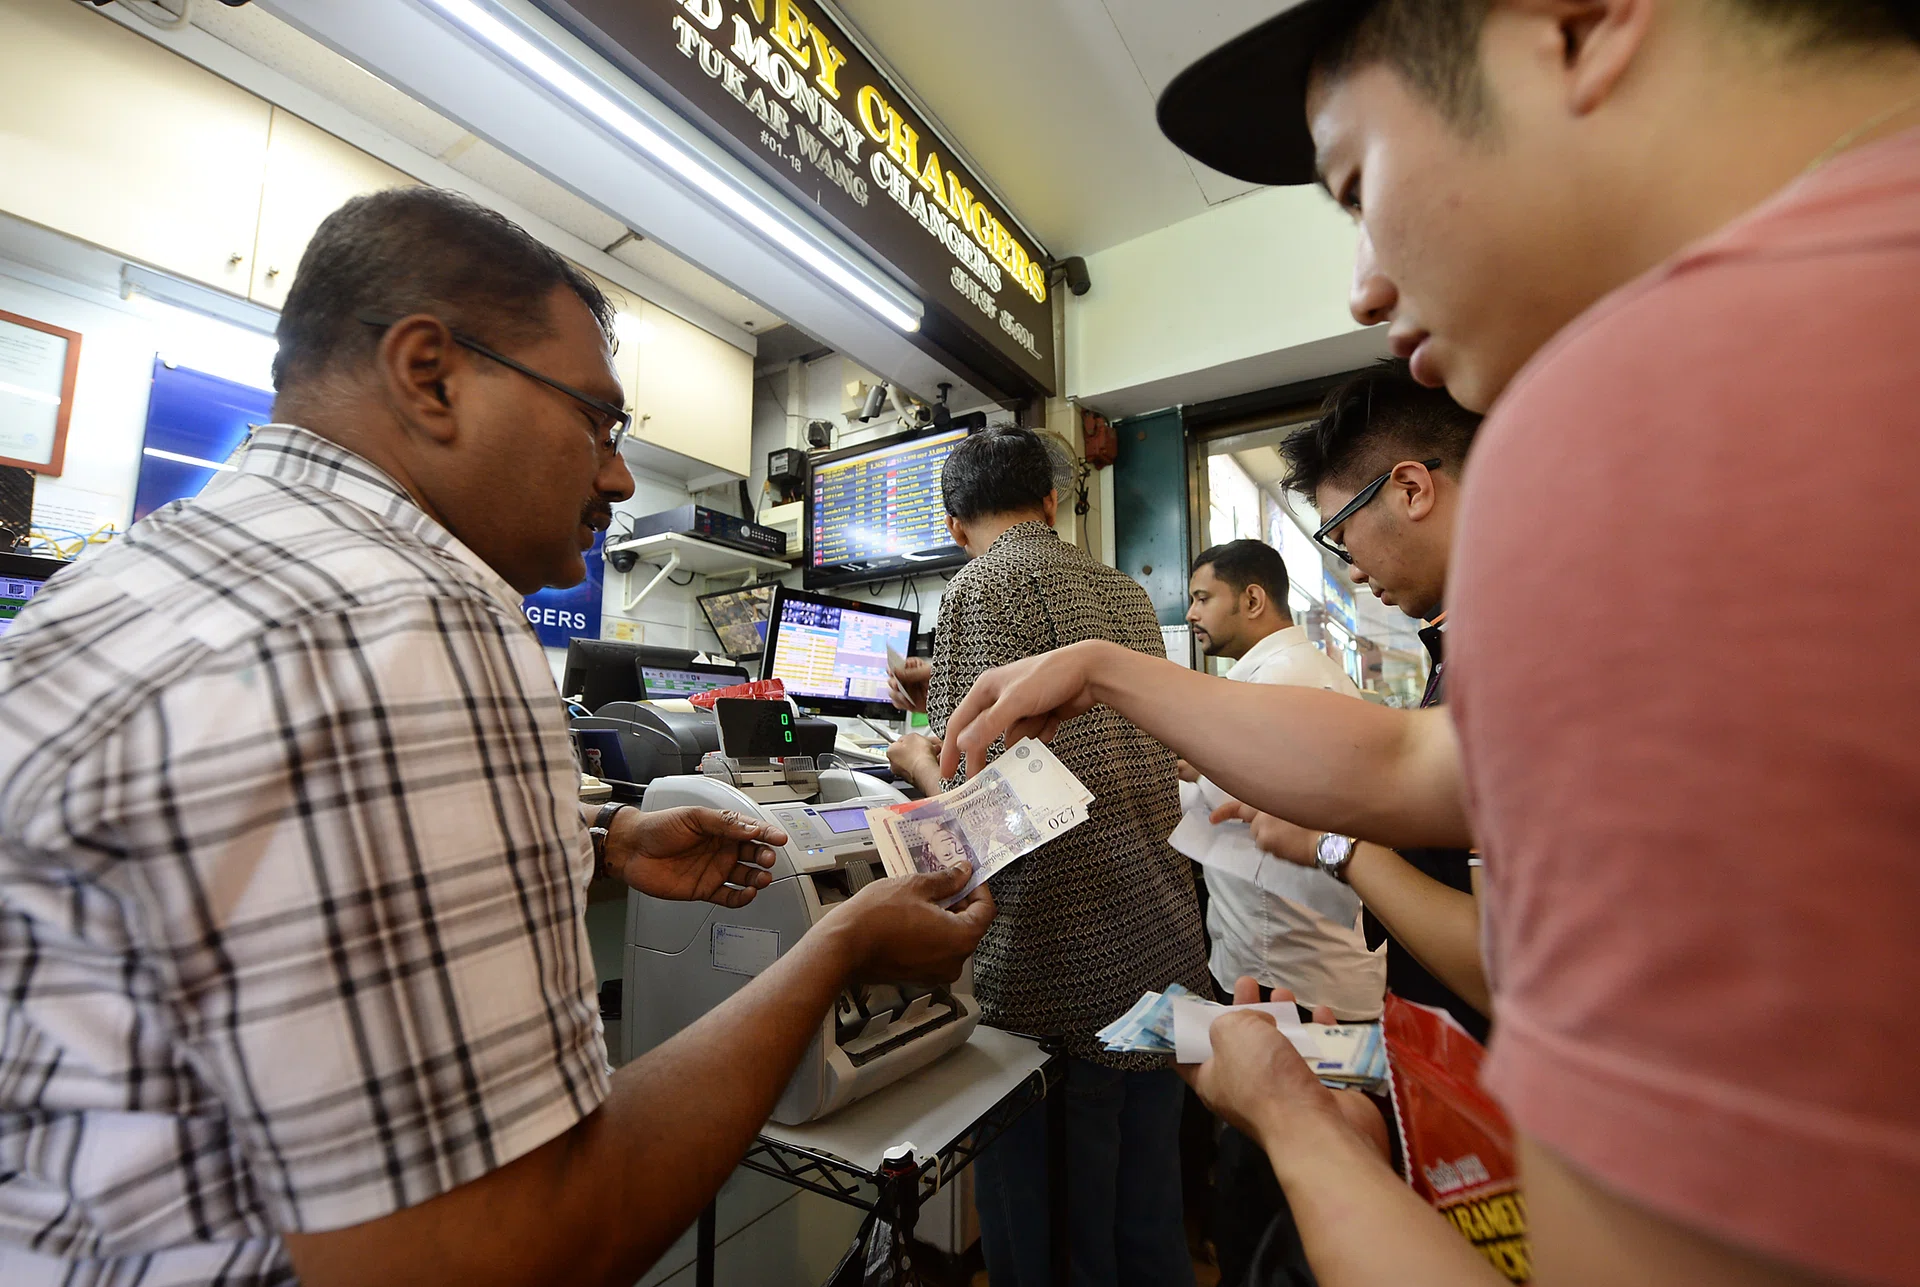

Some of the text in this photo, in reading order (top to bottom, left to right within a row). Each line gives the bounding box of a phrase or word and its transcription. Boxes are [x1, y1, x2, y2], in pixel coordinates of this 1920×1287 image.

[672, 15, 869, 207] TUKAR WANG
[730, 13, 866, 165] MONEY
[869, 151, 1002, 293] CHANGERS
[760, 130, 802, 173] #01-18
[856, 85, 1046, 304] CHANGERS
[520, 606, 586, 630] GERS
[781, 713, 789, 726] 0
[785, 731, 793, 743] 0
[1048, 805, 1075, 830] £20
